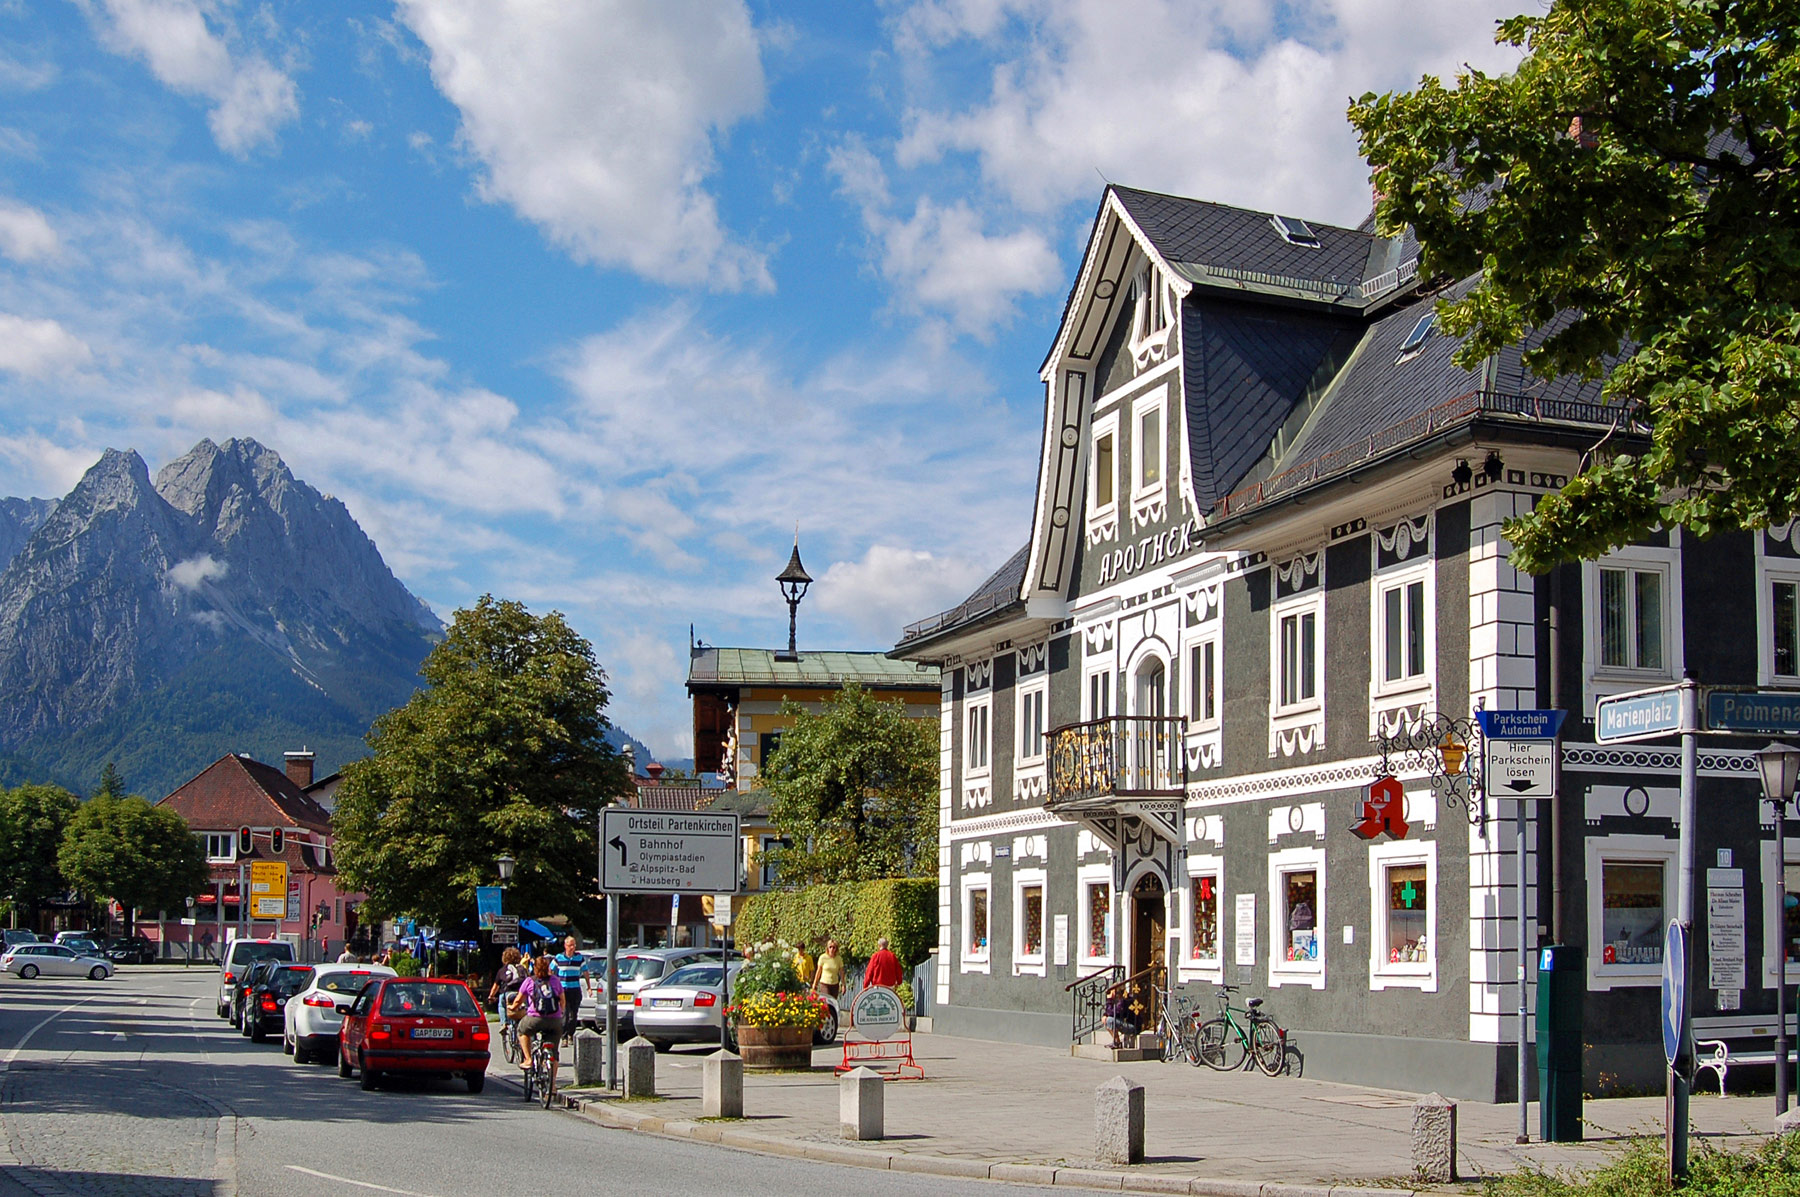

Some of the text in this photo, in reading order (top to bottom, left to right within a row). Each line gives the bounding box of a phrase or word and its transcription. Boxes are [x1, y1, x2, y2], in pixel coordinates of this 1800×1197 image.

[1493, 713, 1548, 724] Parkschein
[1607, 701, 1672, 730] Marienplatz
[1500, 725, 1542, 735] Automat
[1509, 743, 1531, 752] Hier
[1491, 755, 1551, 765] Parkschein
[1506, 767, 1535, 777] lösen
[628, 817, 733, 832] Ortsteil Partenkirchen
[640, 839, 684, 850] Bahnhof
[640, 852, 705, 862] Olympiastadien
[1720, 852, 1729, 863] 10
[640, 865, 696, 874] Alpspitz-Bad
[639, 876, 681, 887] Hausberg
[415, 1029, 428, 1037] GAP
[443, 1029, 452, 1037] 22
